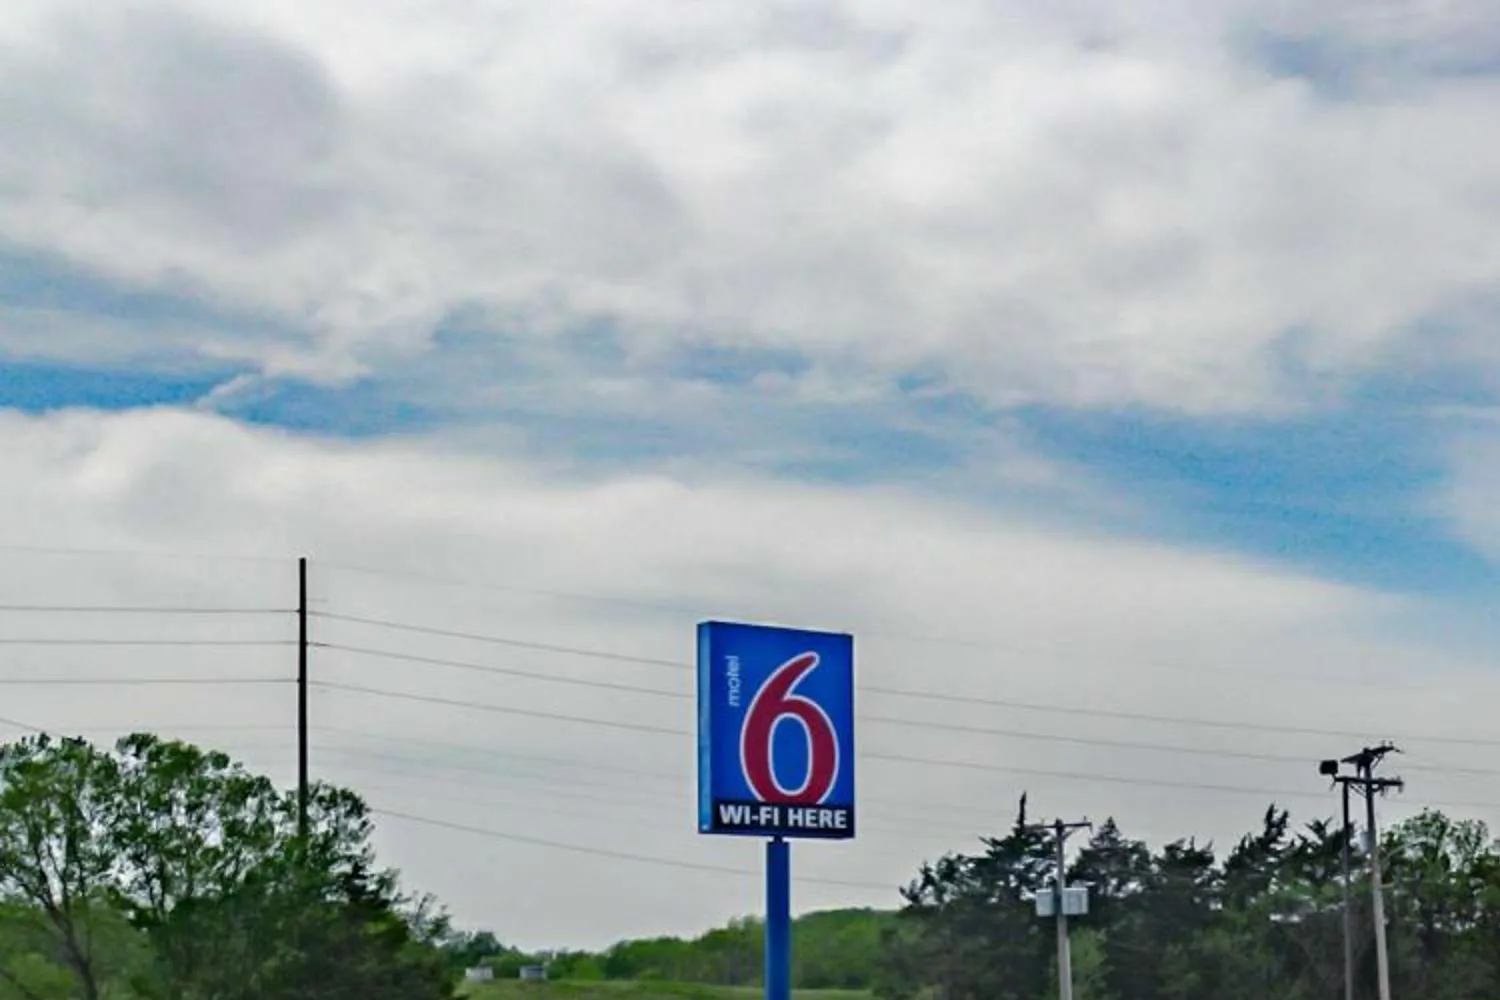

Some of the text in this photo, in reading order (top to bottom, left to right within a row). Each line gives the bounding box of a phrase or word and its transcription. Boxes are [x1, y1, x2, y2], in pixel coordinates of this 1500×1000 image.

[725, 656, 740, 706] motel
[740, 652, 839, 804] 6
[719, 804, 847, 829] WI-FI HERE
